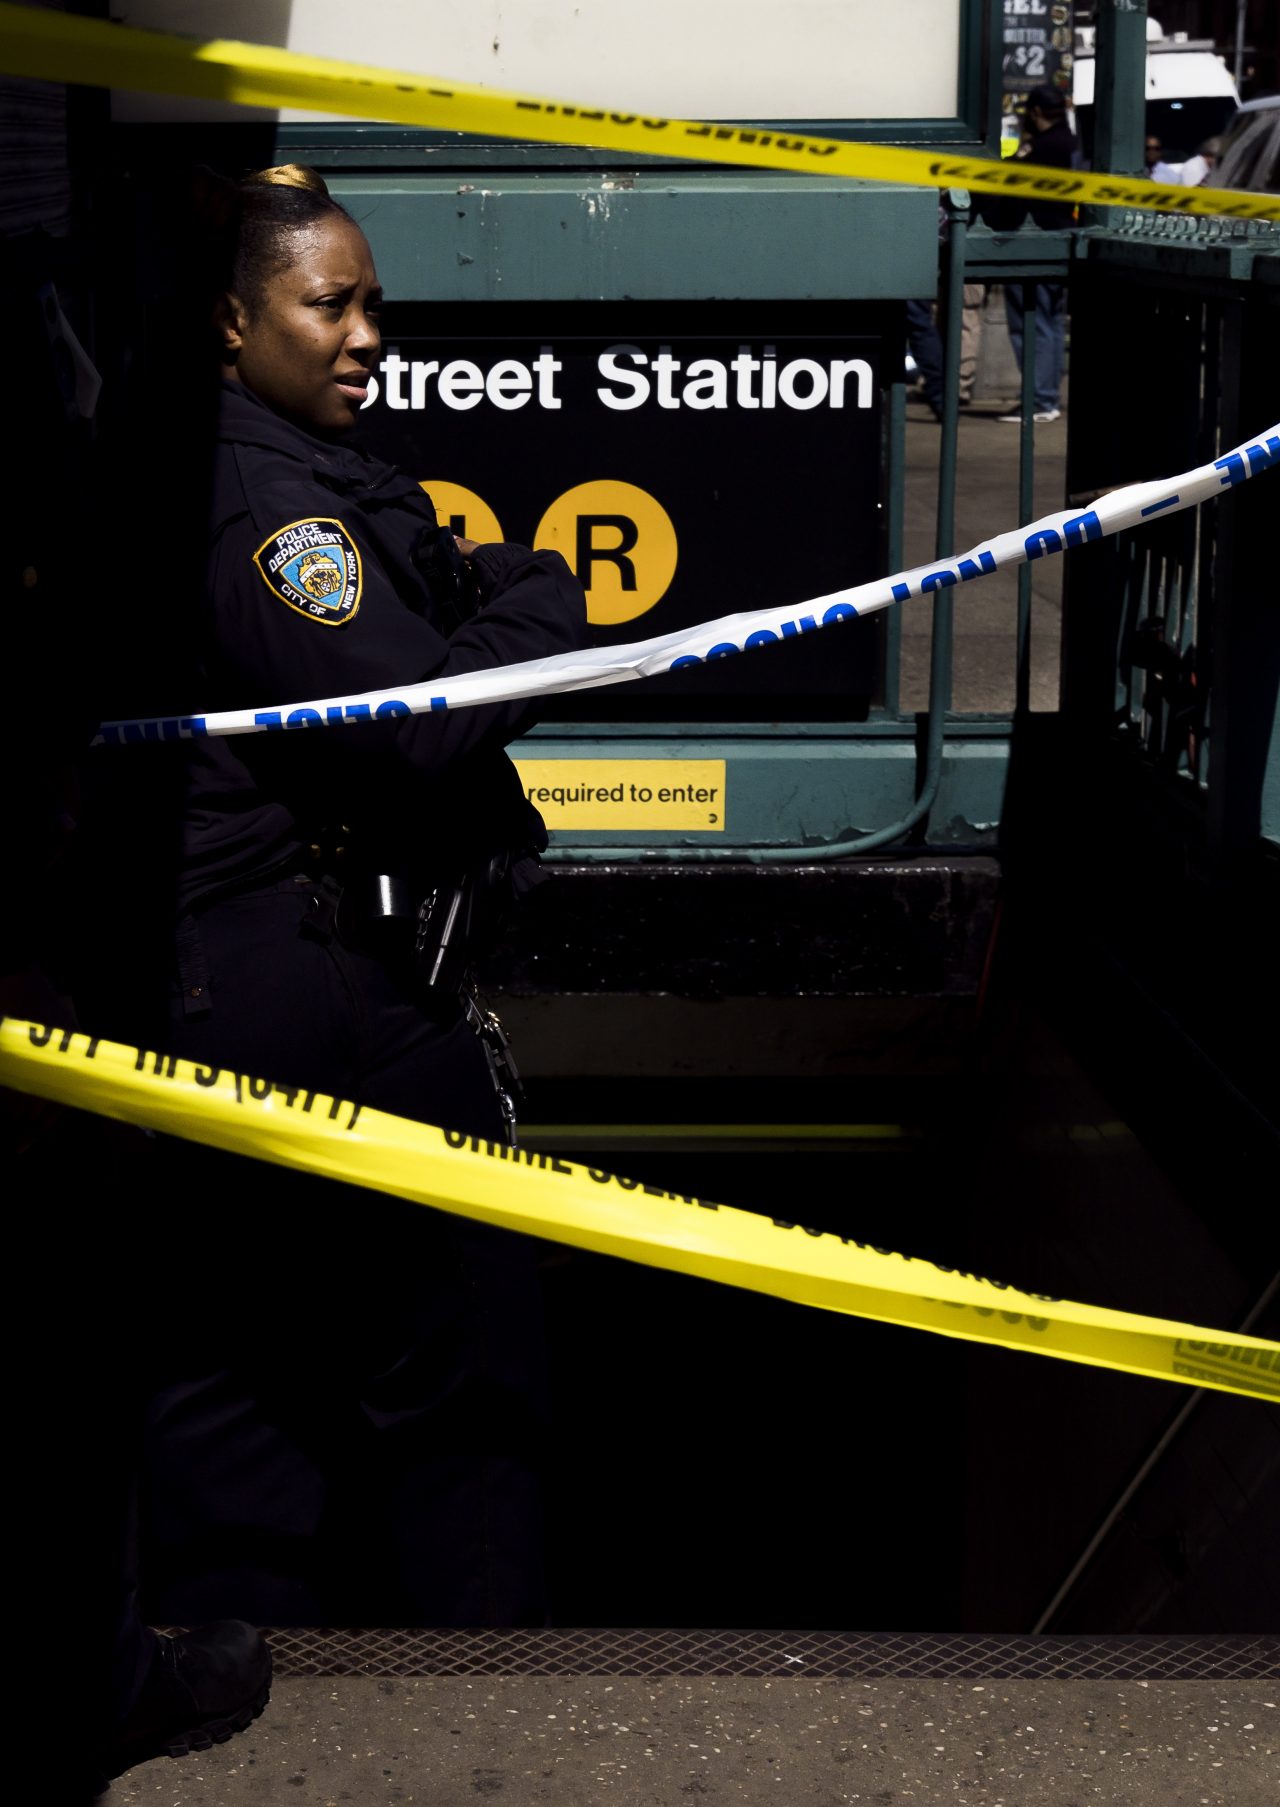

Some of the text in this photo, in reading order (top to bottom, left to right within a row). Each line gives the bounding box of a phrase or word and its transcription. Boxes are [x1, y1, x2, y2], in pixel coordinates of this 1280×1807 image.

[596, 343, 874, 411] Station
[267, 531, 344, 574] DEPARTMENT
[275, 523, 322, 550] POLICE
[575, 514, 639, 591] R
[280, 551, 358, 616] CITY OF NEW YORK
[527, 782, 718, 806] required to enter
